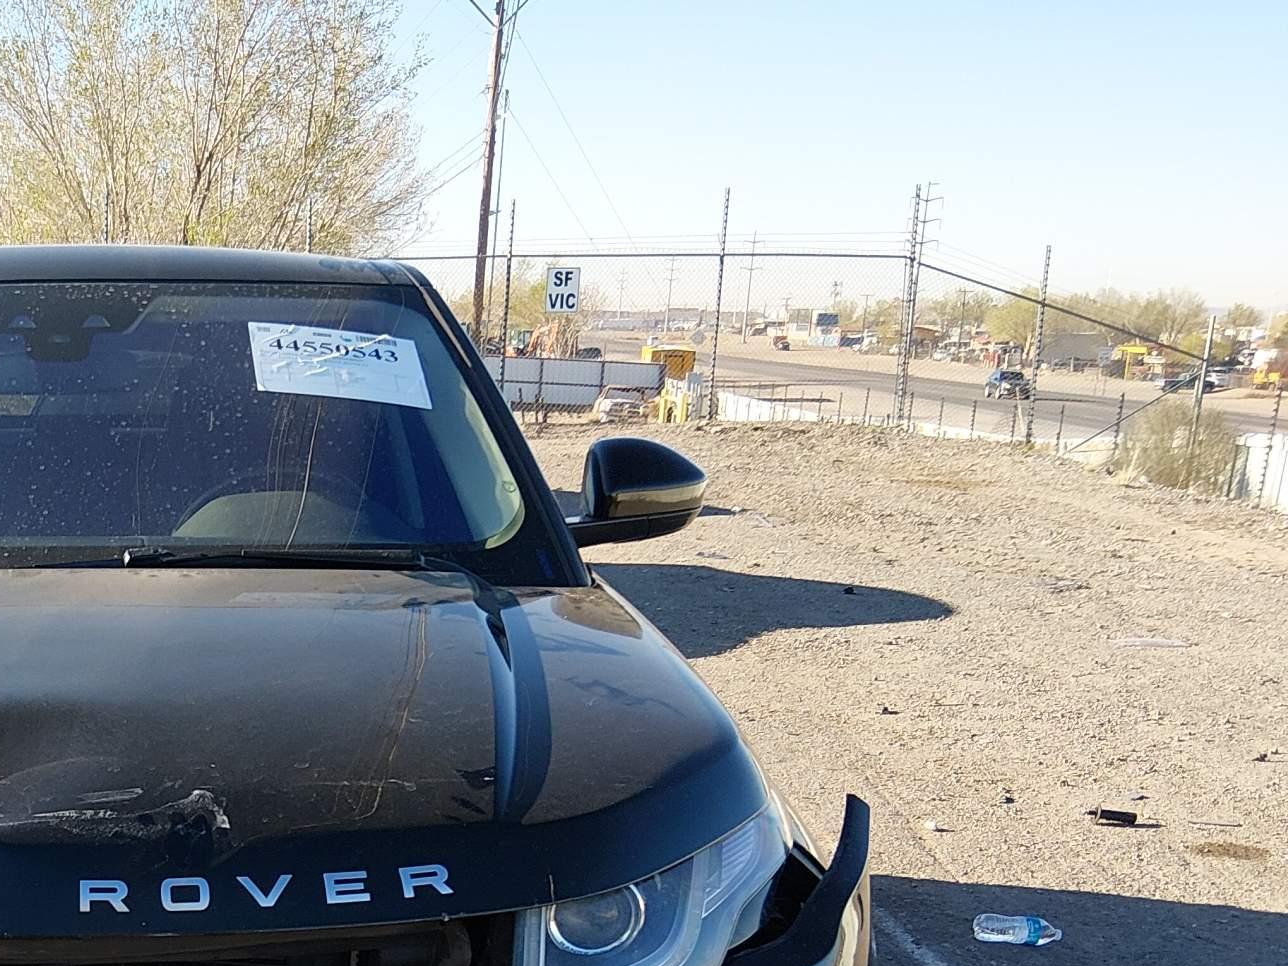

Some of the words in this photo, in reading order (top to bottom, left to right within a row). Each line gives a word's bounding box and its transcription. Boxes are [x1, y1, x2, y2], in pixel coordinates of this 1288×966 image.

[553, 271, 573, 287] SF
[549, 293, 576, 309] VIC
[269, 339, 398, 362] 44550543
[79, 864, 454, 913] ROVER
